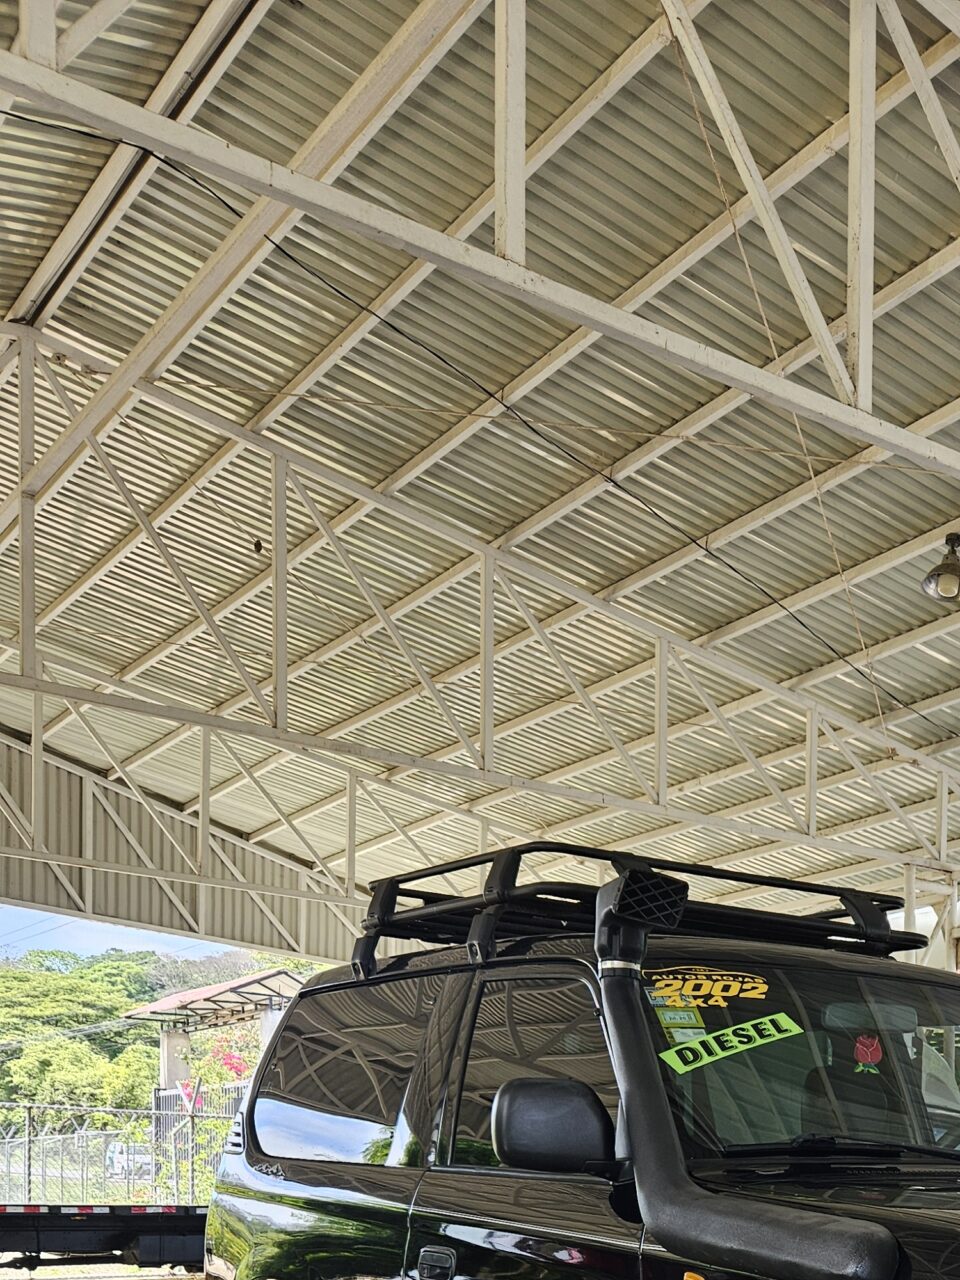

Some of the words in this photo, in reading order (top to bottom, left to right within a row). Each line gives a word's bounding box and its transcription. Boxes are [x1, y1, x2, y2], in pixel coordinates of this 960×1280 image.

[653, 979, 769, 999] 2002
[711, 975, 764, 983] ROJAS
[674, 1017, 792, 1067] DIESEL
